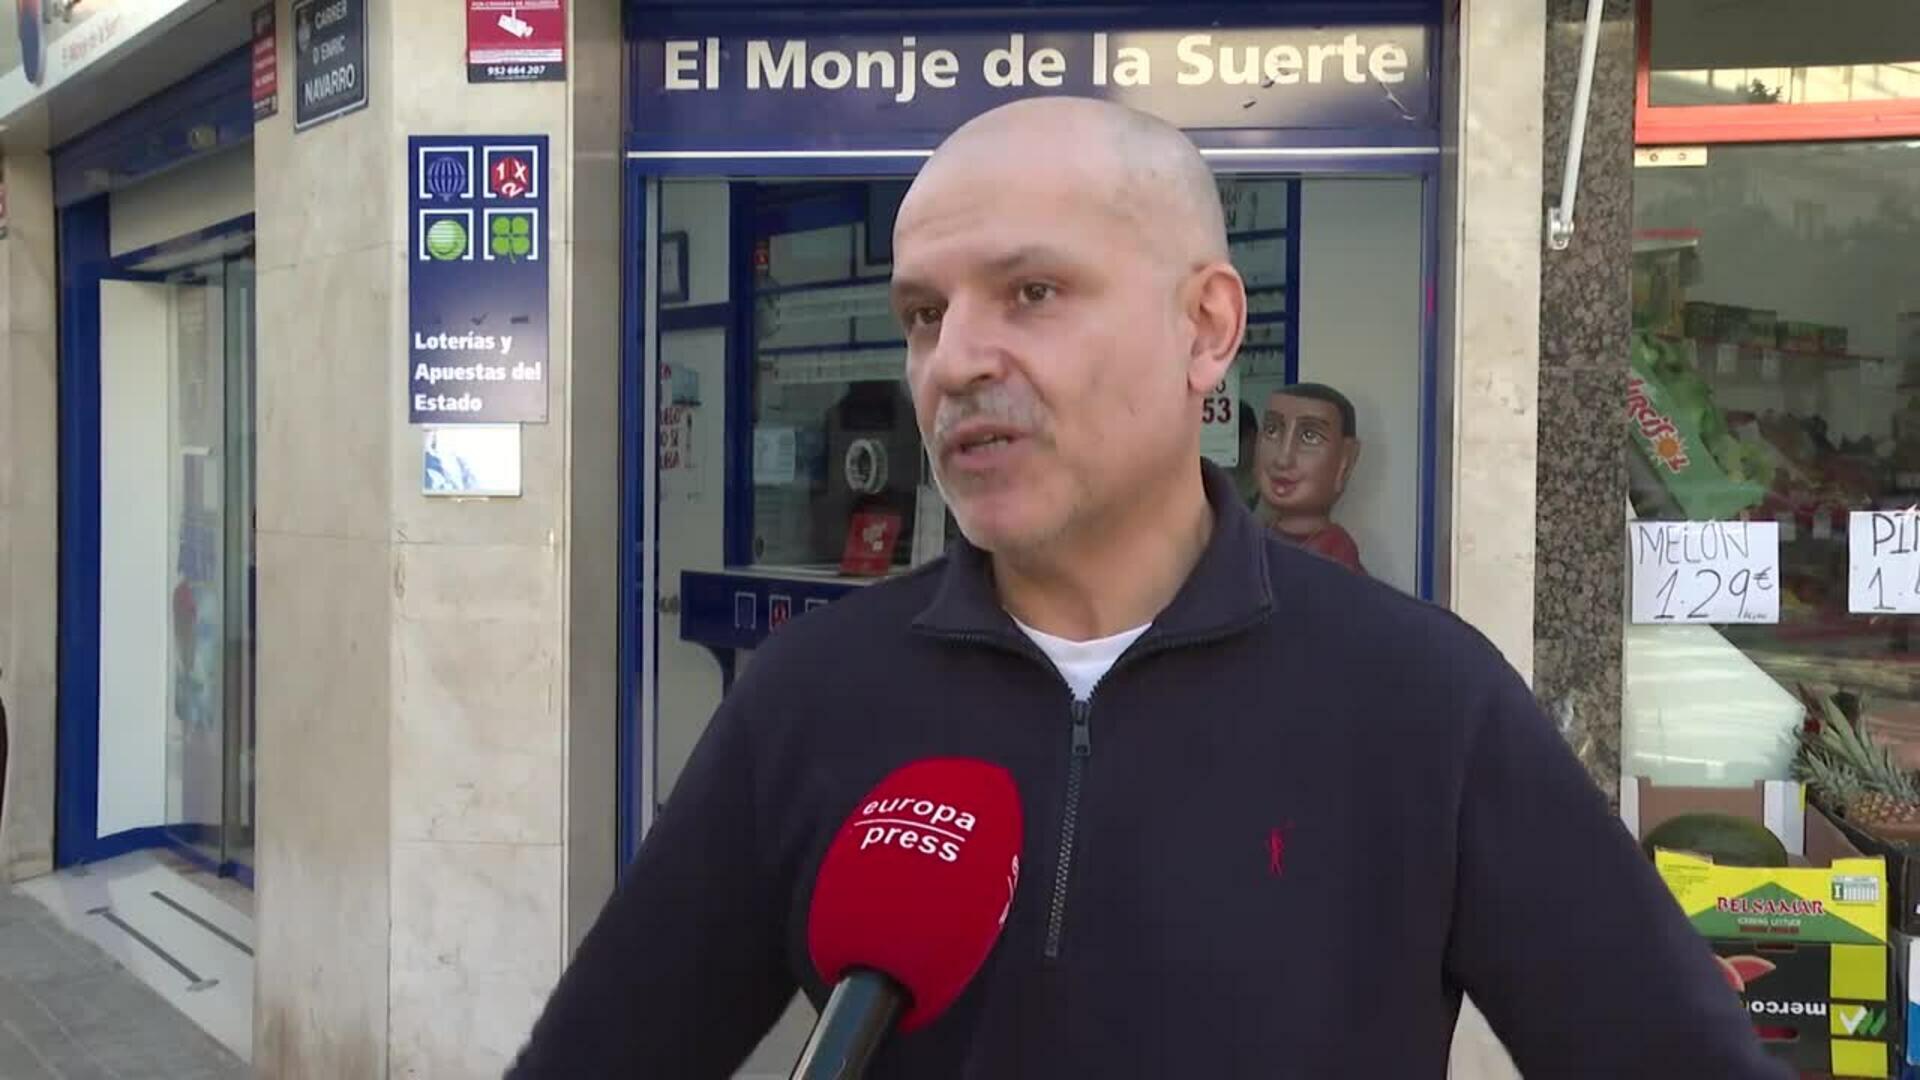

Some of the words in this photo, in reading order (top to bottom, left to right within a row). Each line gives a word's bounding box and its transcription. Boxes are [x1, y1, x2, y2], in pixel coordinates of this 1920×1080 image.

[664, 39, 720, 90] El
[747, 36, 959, 103] Monje
[983, 33, 1066, 88] de
[1093, 33, 1152, 87] la
[1176, 33, 1407, 86] Suerte
[305, 63, 355, 106] NAVARRO
[414, 331, 495, 350] Loterías
[500, 335, 513, 355] y
[414, 362, 507, 384] Apuestas
[511, 361, 542, 381] del
[414, 393, 483, 412] Estado
[862, 797, 976, 832] europa
[860, 826, 961, 863] press
[1746, 1000, 1828, 1017] merco
